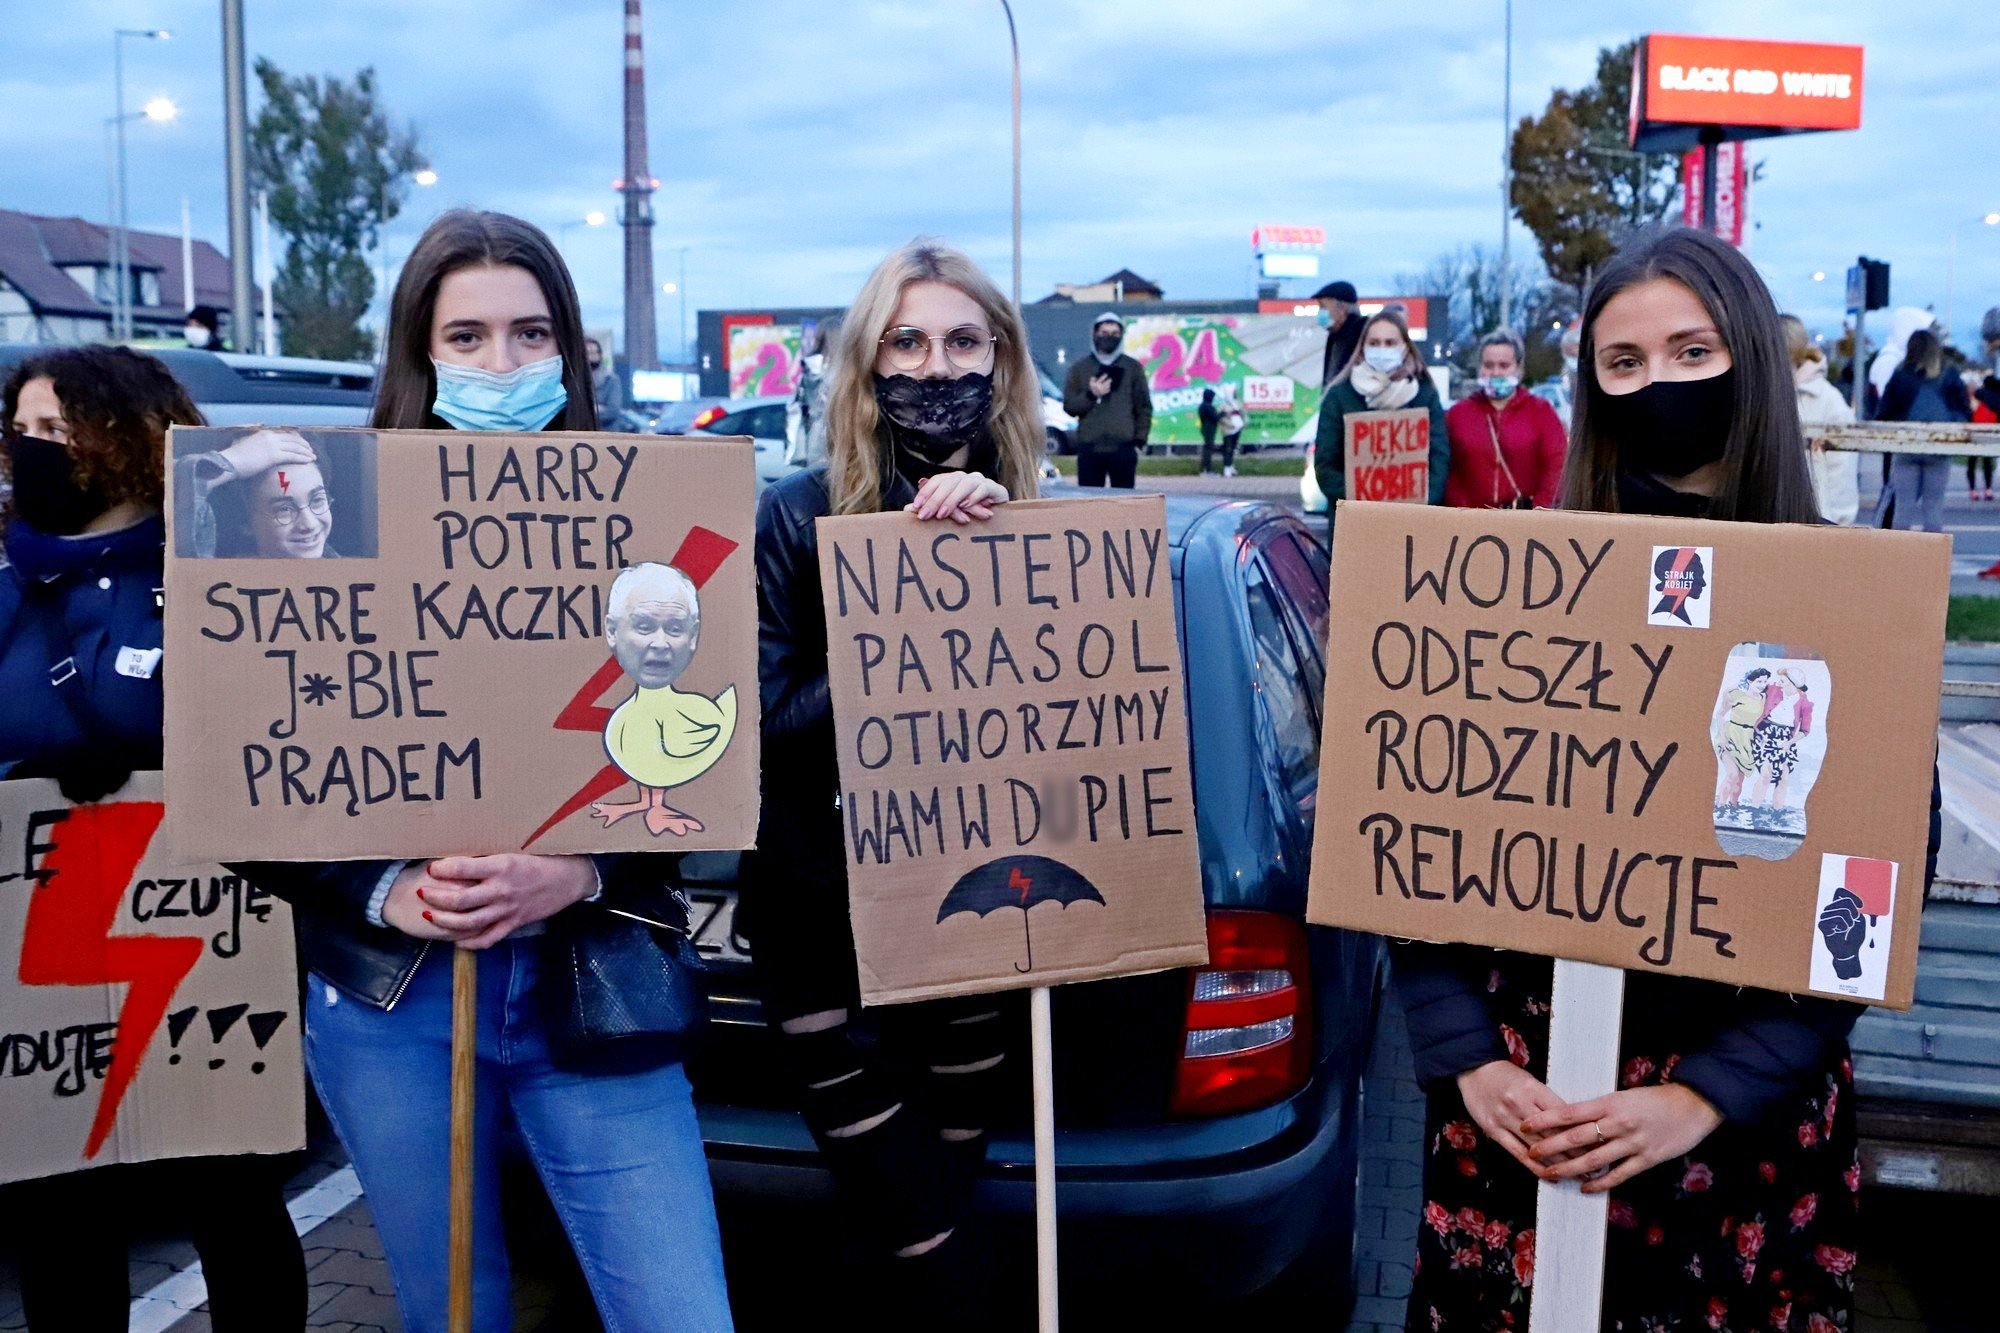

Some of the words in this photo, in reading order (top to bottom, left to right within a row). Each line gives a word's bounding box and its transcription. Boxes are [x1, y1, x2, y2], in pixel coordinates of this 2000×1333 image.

[1660, 65, 1730, 92] BLACK
[1733, 69, 1778, 94] RED
[1782, 72, 1851, 98] WHITE
[757, 342, 801, 396] 2
[1150, 328, 1225, 391] 24
[438, 443, 638, 502] HARRY
[1354, 462, 1427, 501] KOBIET
[433, 511, 634, 570] POTTER
[834, 528, 1161, 617] NASTĘPNY
[1405, 534, 1615, 615] WODY
[1664, 570, 1694, 580] STRAJK
[201, 582, 376, 645] STARE
[413, 581, 602, 640] KACZKI
[1664, 581, 1693, 589] KOBIET
[854, 620, 1170, 696] PARASOL
[1371, 621, 1674, 715] ODESZŁY
[857, 686, 1169, 769] OTWORZYMY
[1365, 709, 1679, 817] RODZIMY
[243, 738, 482, 816] PRĄDEM
[849, 786, 945, 864] WAM
[957, 783, 991, 850] W
[132, 875, 273, 958] CZUJĘ
[1359, 812, 1739, 966] REWOLUCJĘ
